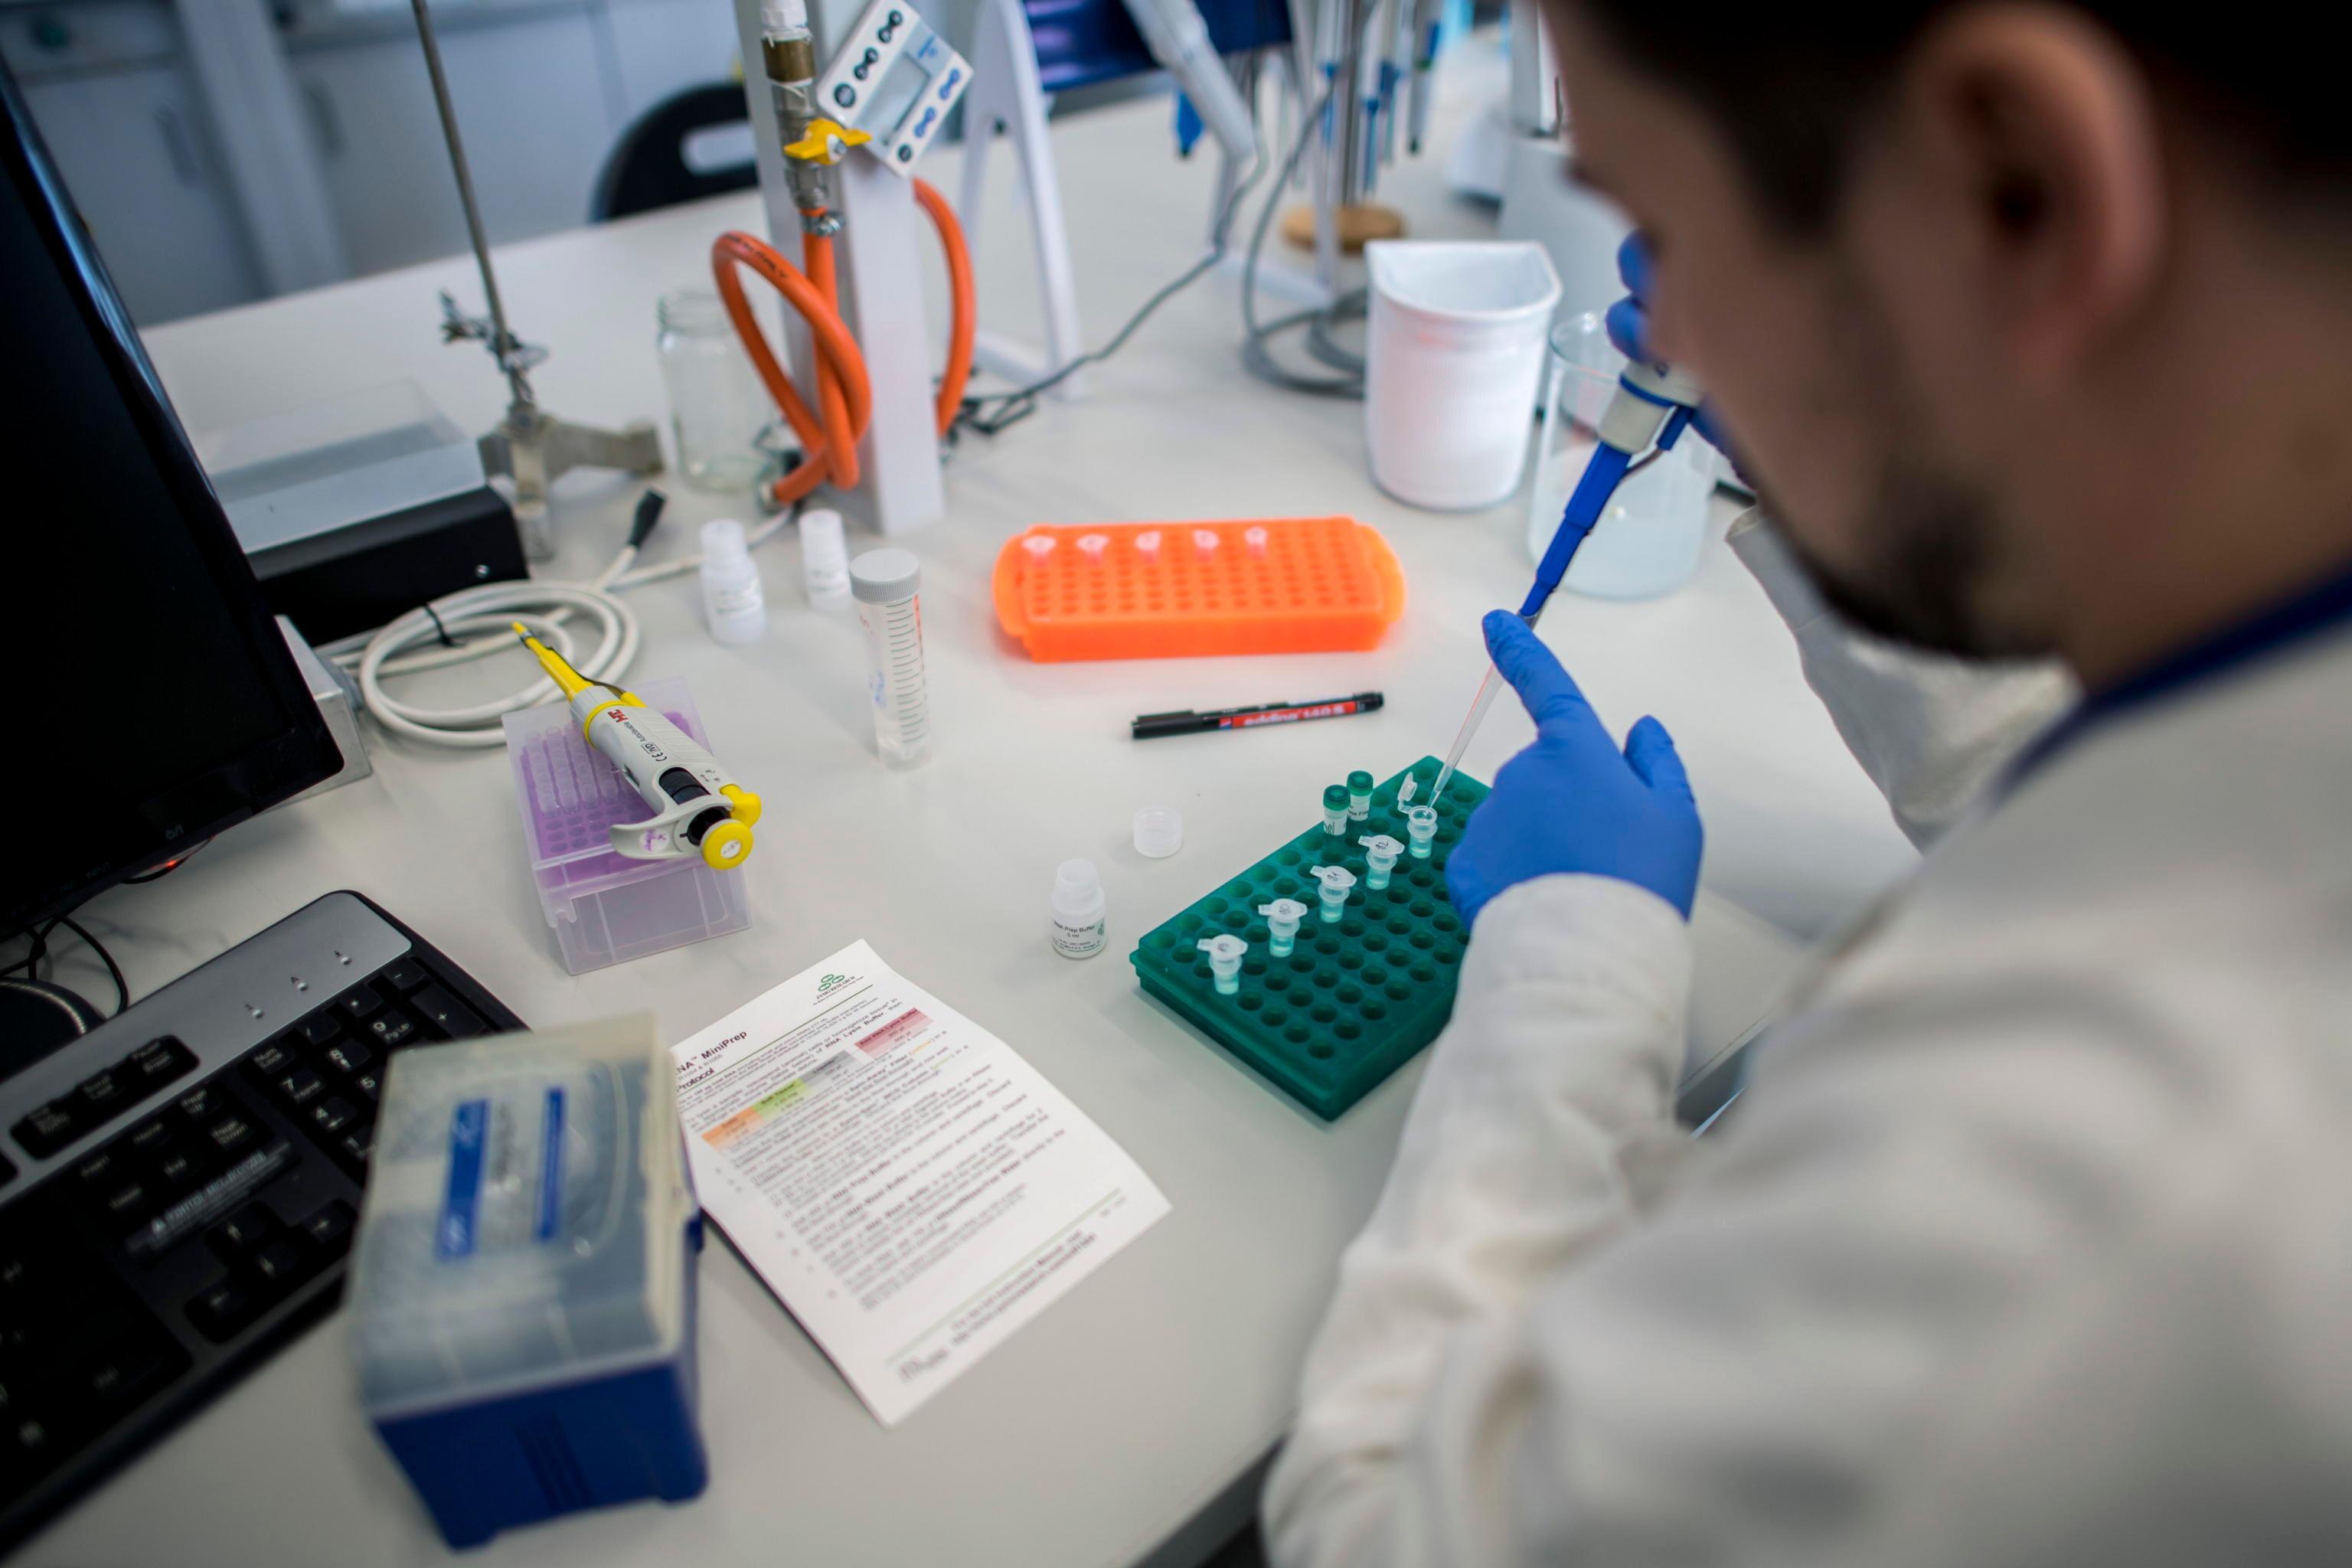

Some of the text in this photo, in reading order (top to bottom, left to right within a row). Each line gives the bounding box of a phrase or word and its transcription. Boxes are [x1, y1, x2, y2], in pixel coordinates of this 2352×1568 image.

[373, 1021, 387, 1031] 9
[701, 1031, 747, 1060] MiniPrep
[329, 1048, 343, 1060] 8
[282, 1077, 295, 1089] 7
[361, 1076, 376, 1089] 5
[315, 1106, 328, 1120] 4
